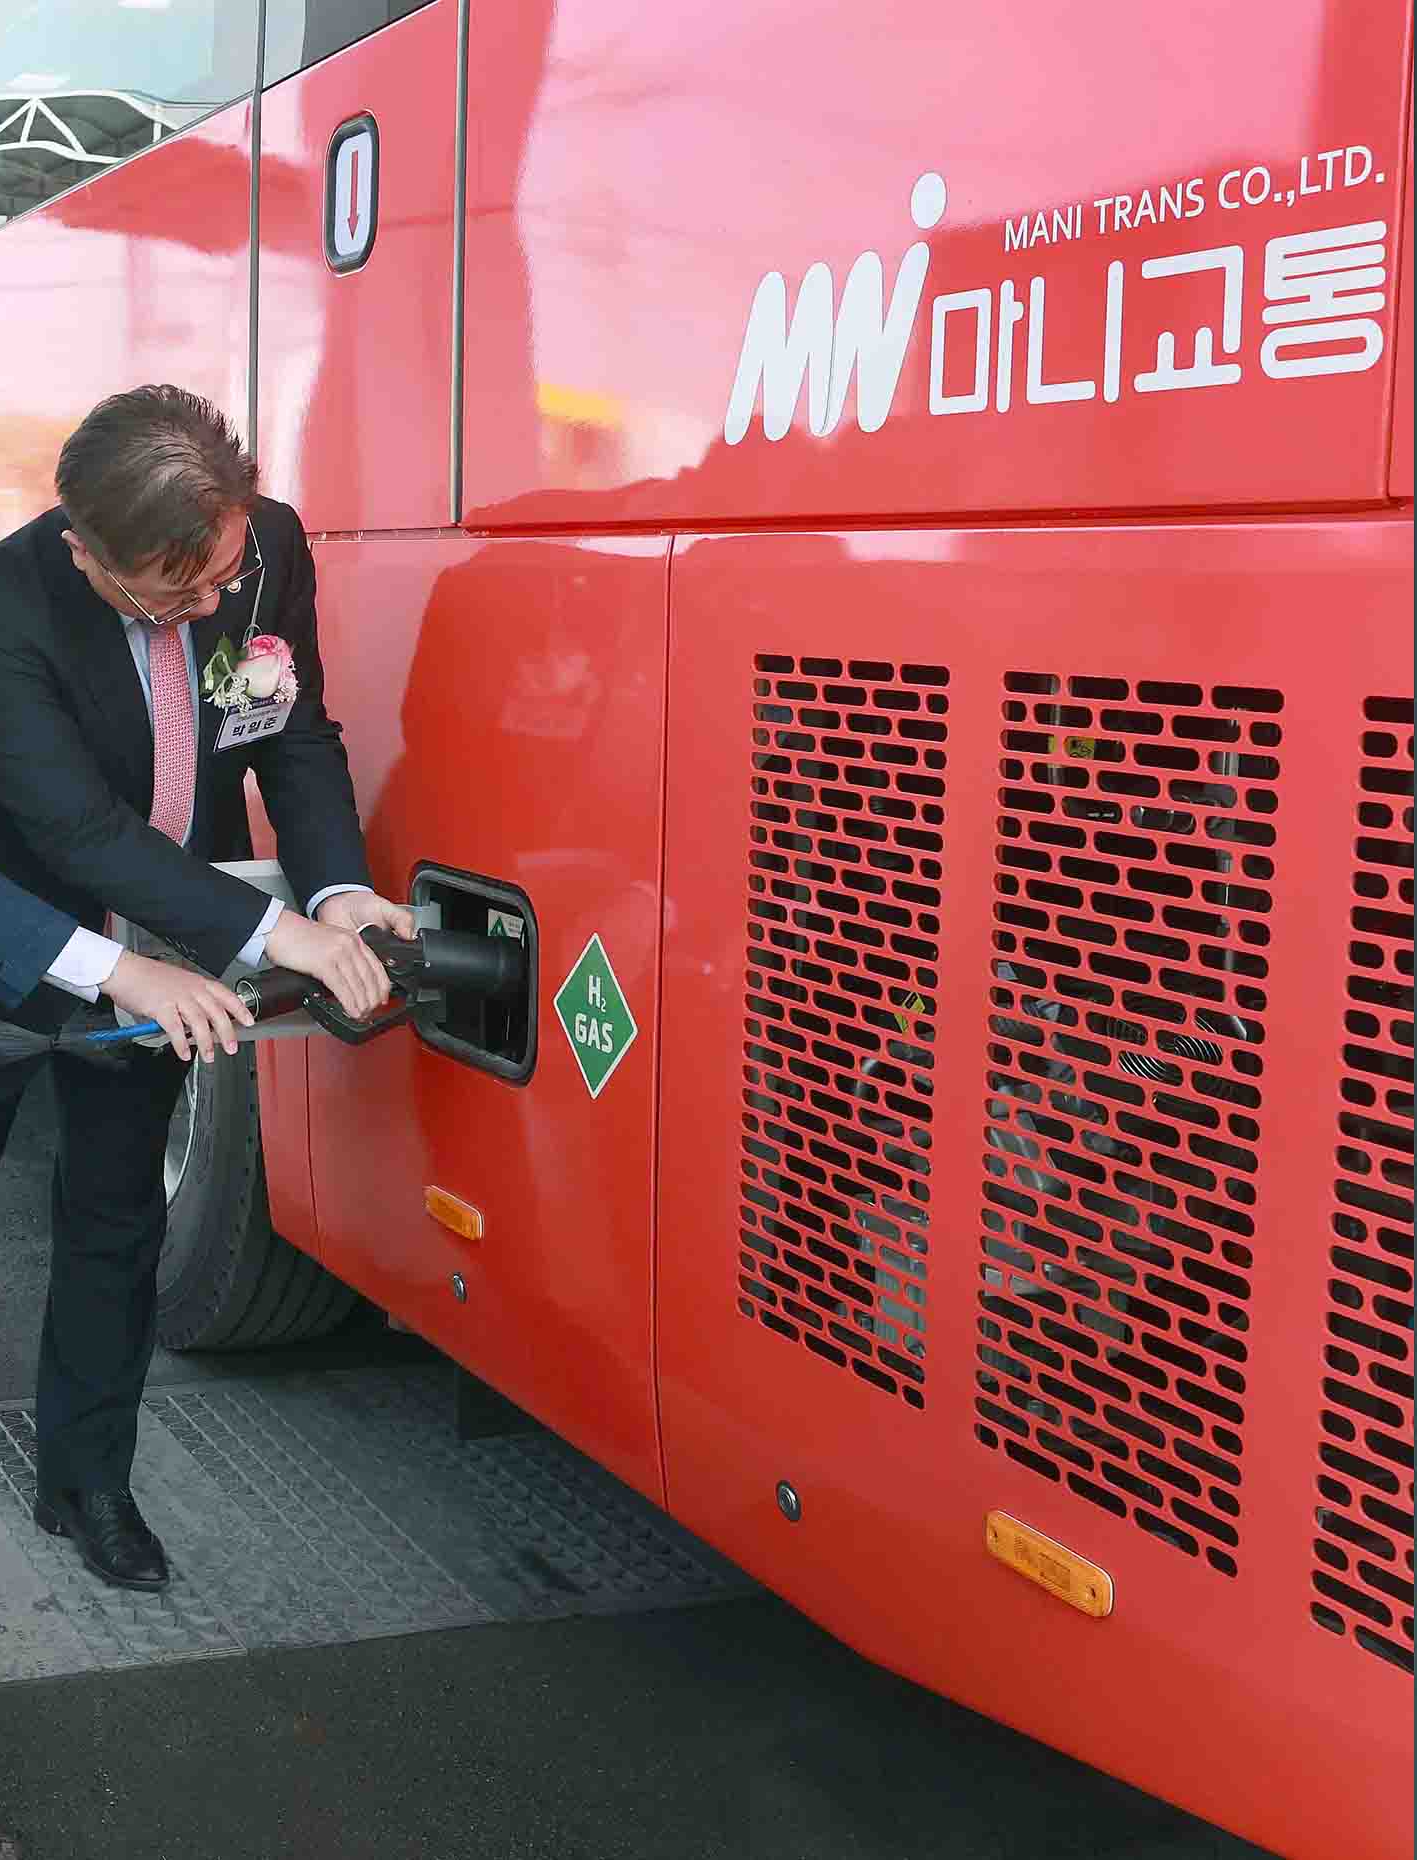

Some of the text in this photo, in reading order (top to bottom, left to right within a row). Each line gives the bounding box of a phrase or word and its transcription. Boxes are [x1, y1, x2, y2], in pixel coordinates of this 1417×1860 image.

[1003, 144, 1386, 253] MANI TRANS CO.,LTD.
[928, 220, 1388, 416] 마니교통
[575, 1012, 613, 1054] GAS
